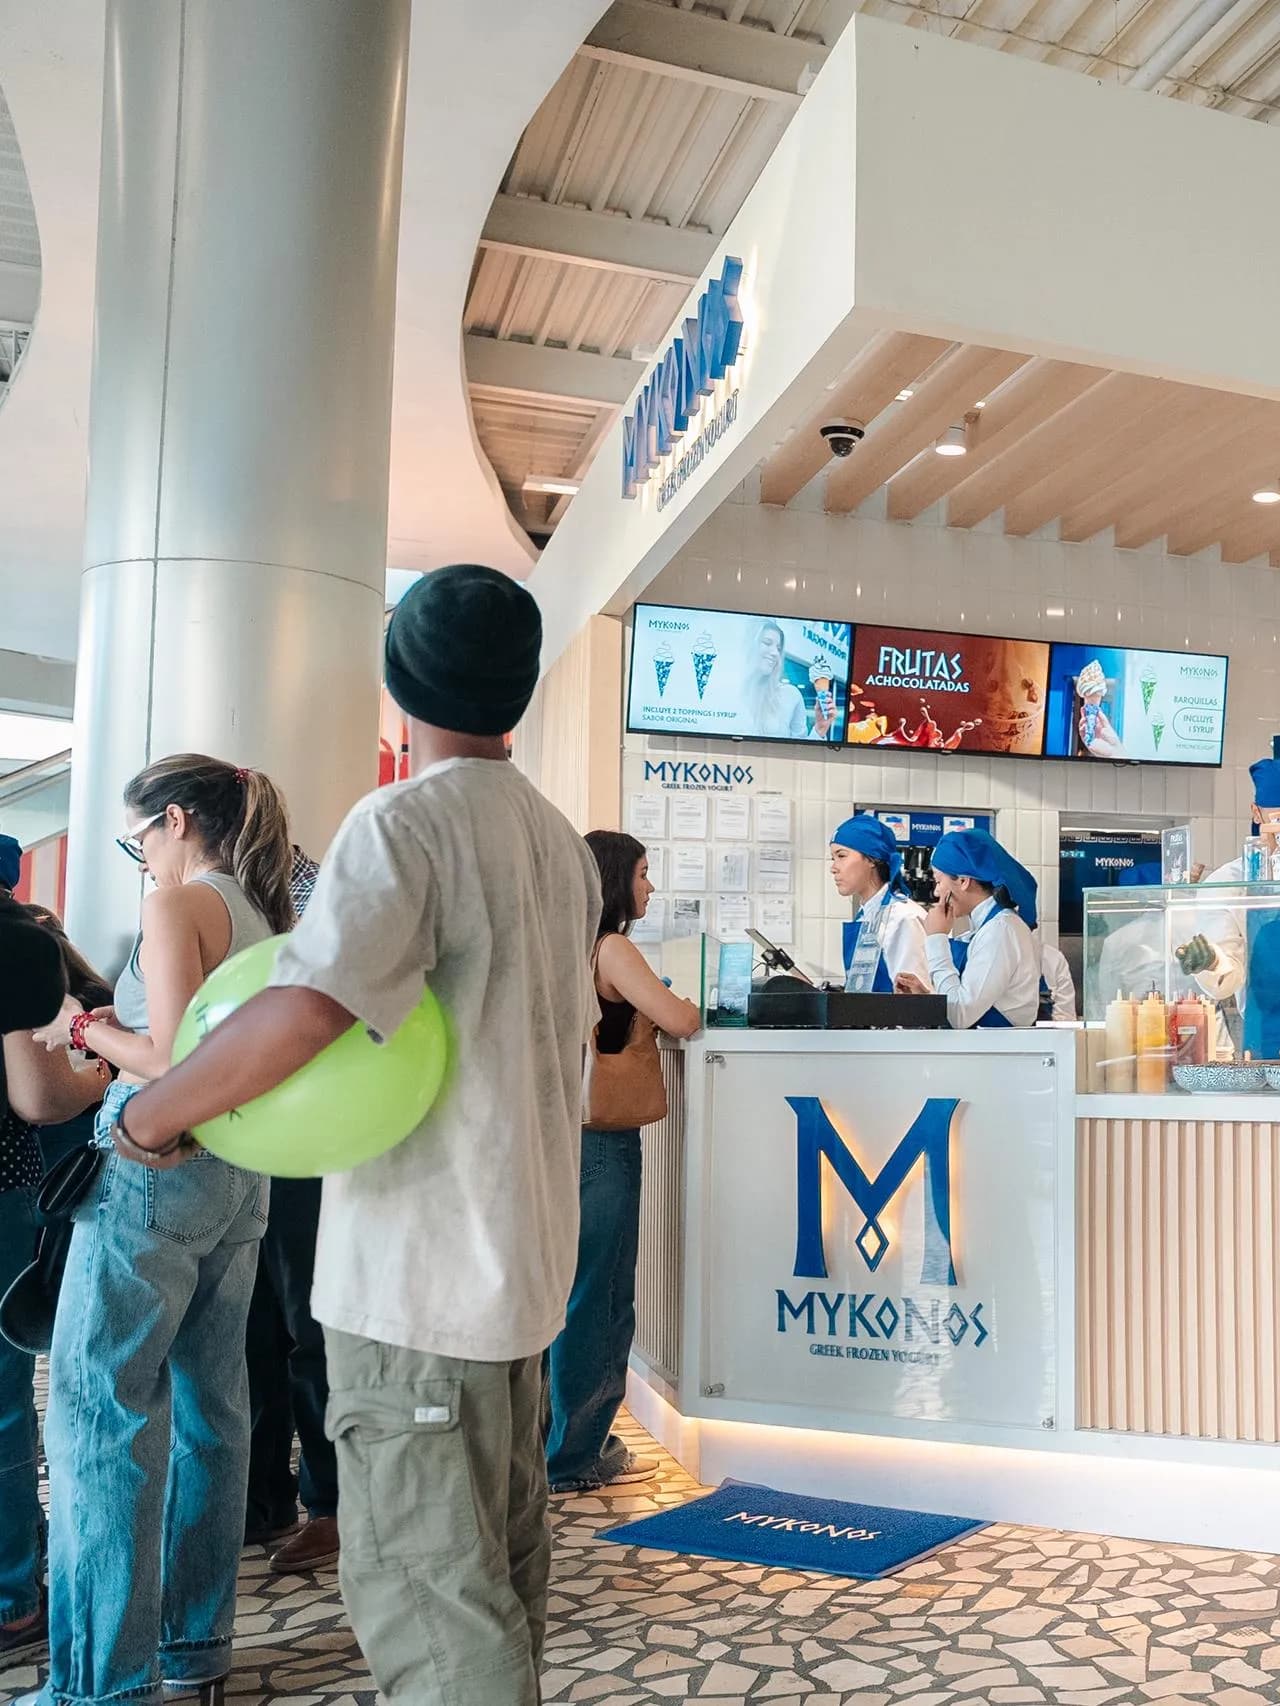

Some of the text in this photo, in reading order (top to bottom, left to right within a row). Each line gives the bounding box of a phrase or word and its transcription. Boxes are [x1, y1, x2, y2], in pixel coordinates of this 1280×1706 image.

[649, 619, 690, 631] MYKONOS
[877, 645, 963, 680] FRUTAS
[1180, 666, 1218, 677] MYKONOS
[865, 674, 970, 693] ACHOCOLATADAS
[1173, 696, 1218, 706] BARQUILLAS
[643, 706, 671, 714] INCLUYE
[677, 708, 712, 717] TOPPINGS
[717, 711, 737, 719] SYRUP
[1183, 715, 1214, 724] INCLUYE
[1193, 726, 1215, 735] SYRUP
[643, 760, 754, 785] MYKONOS
[1095, 857, 1134, 868] MYKONOS
[784, 1096, 961, 1286] M
[775, 1289, 989, 1347] MYKONOS
[809, 1343, 844, 1358] GREEK
[846, 1346, 890, 1361] FROZEN
[723, 1511, 882, 1541] MYKONOS
